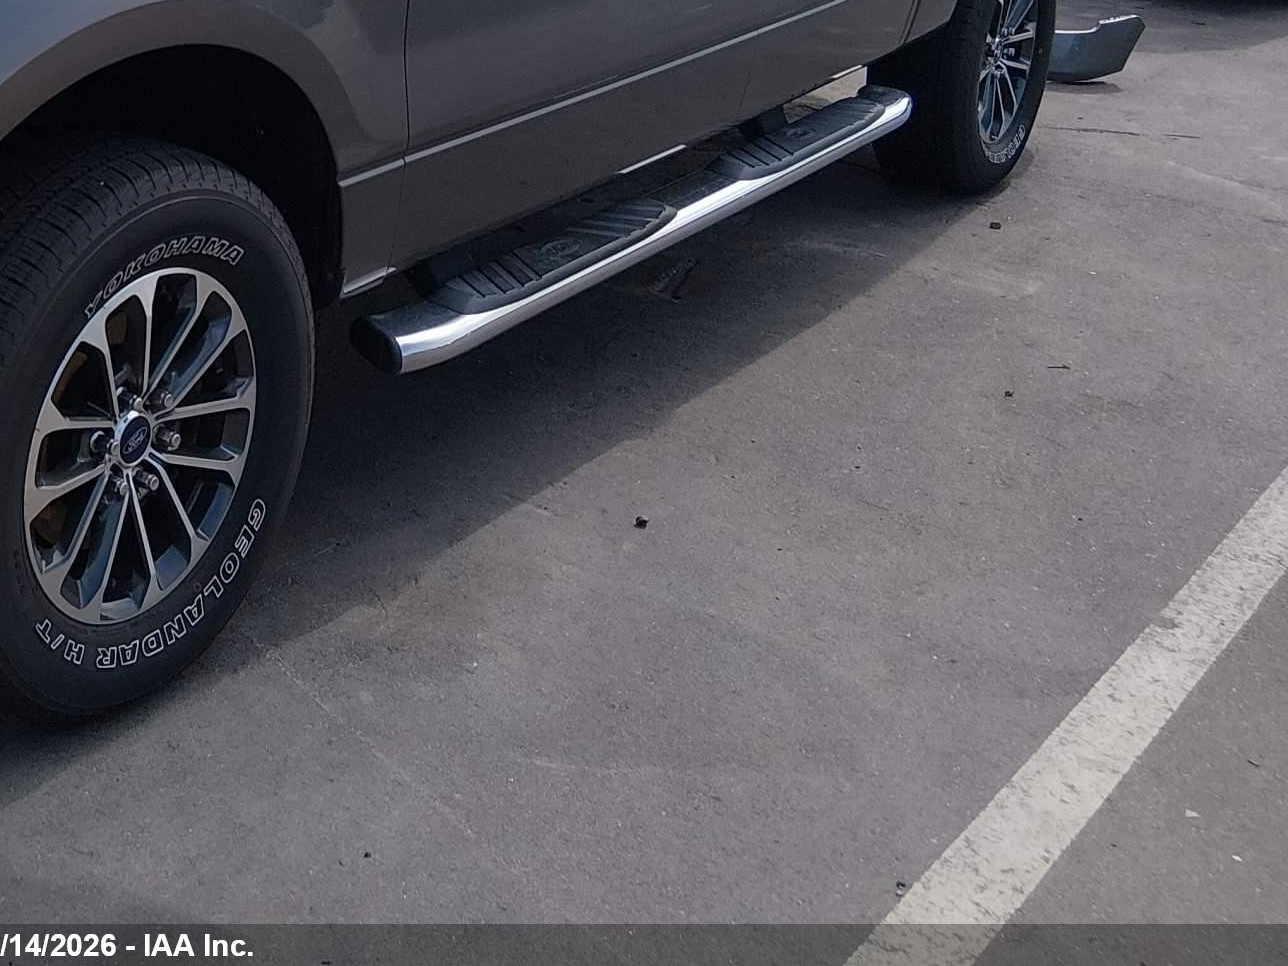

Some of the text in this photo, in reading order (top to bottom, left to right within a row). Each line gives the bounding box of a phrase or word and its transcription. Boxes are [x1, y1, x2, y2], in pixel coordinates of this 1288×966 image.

[84, 236, 245, 319] YOKOHAMA
[35, 498, 267, 670] GEOLANDAR H/T
